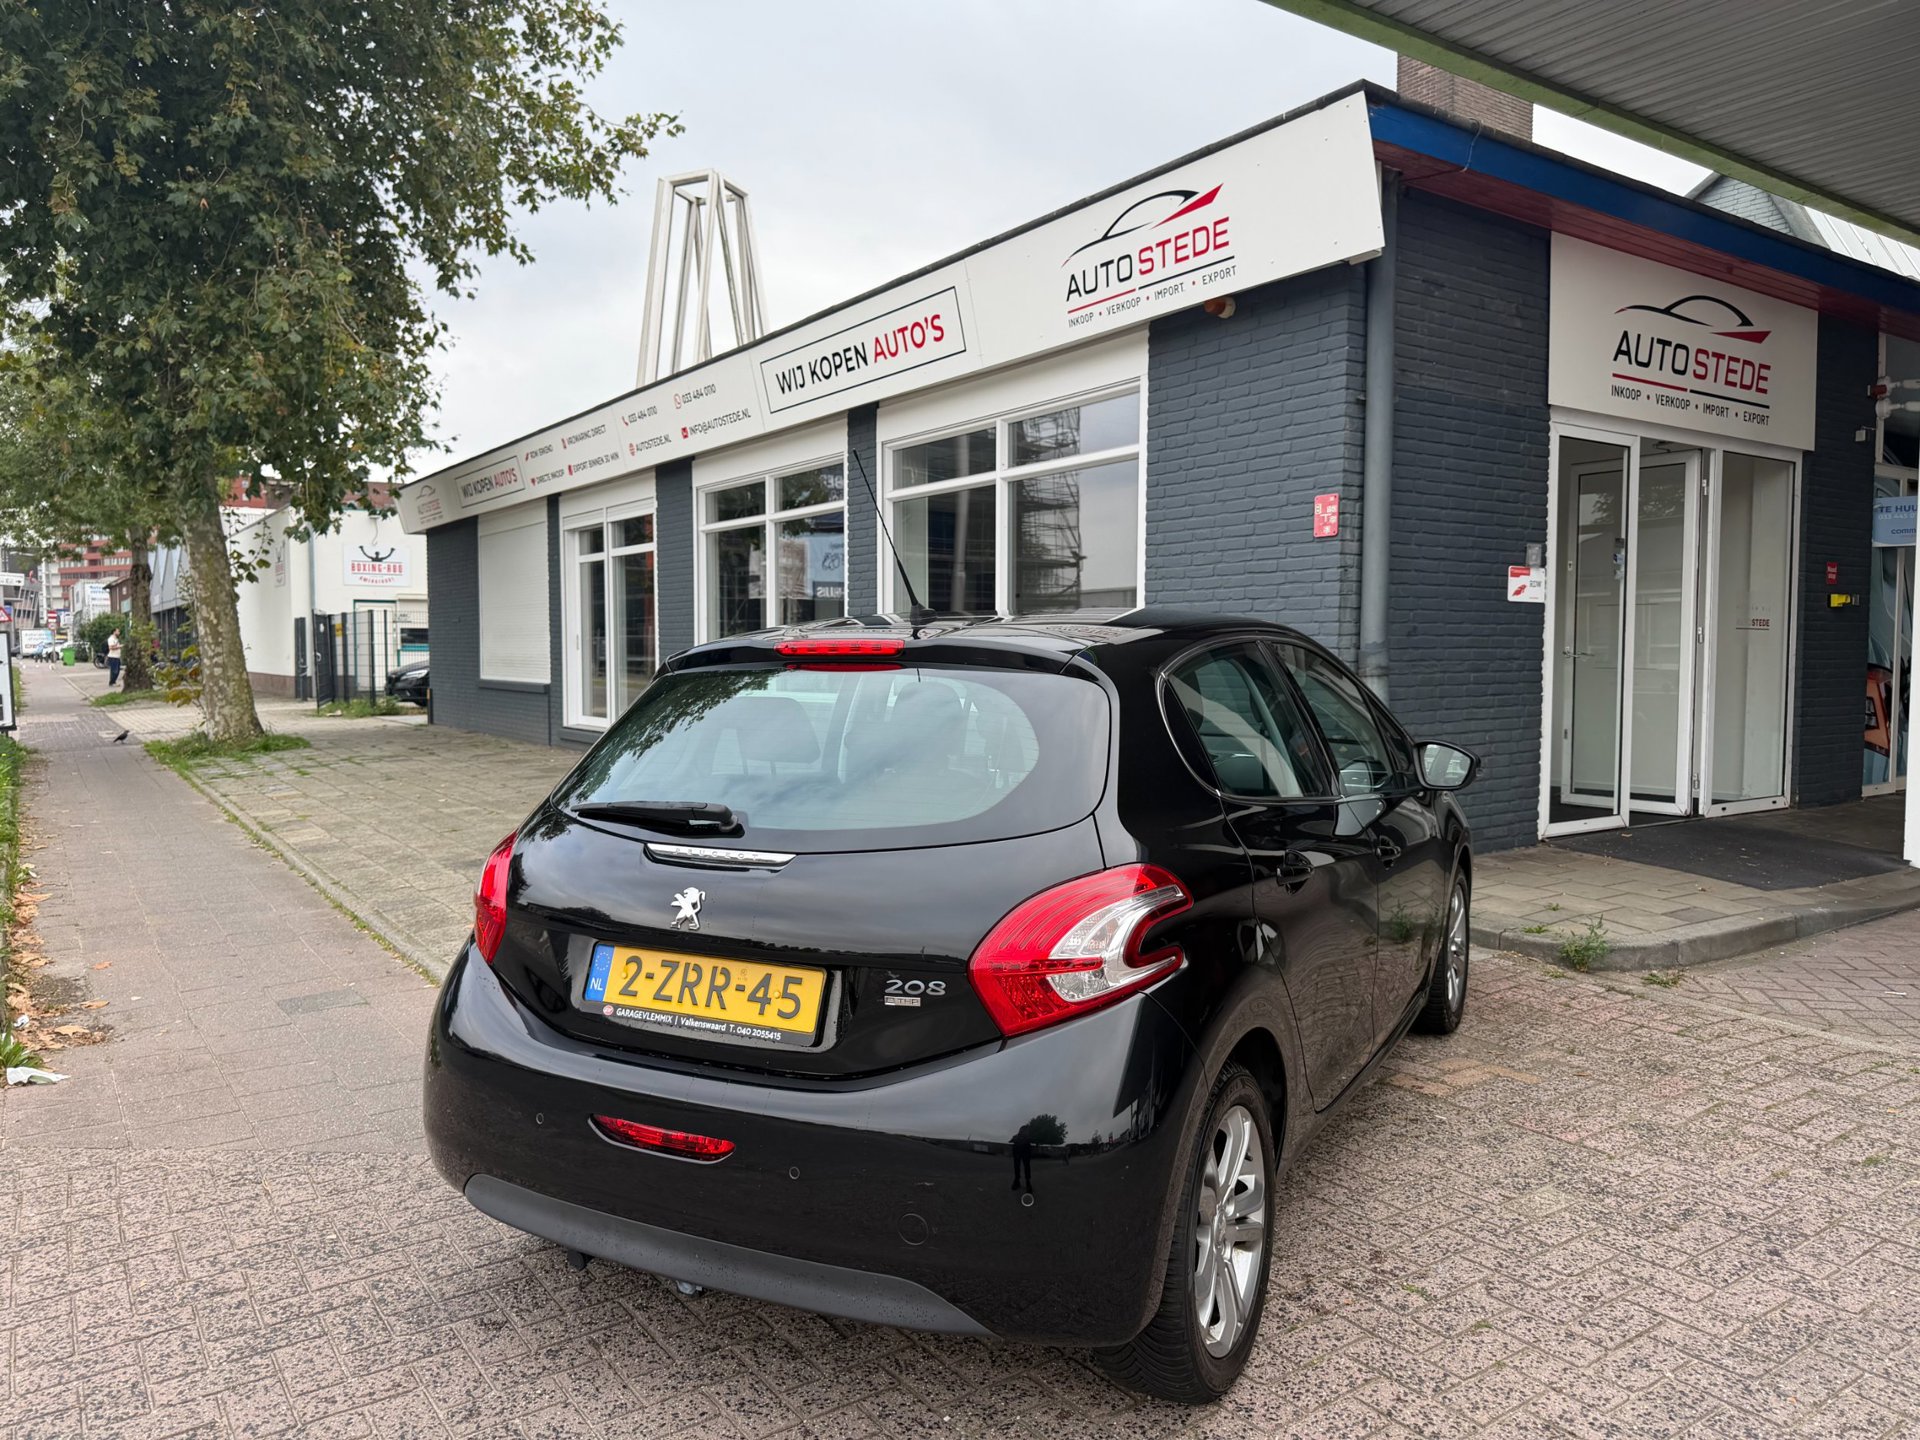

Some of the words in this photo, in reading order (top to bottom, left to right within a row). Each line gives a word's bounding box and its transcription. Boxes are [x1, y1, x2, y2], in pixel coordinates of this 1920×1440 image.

[1068, 311, 1094, 328] INKOOP
[1106, 296, 1141, 316] VERKOOP
[1154, 282, 1184, 301] IMPORT
[1202, 265, 1237, 285] EXPORT
[775, 365, 805, 395] WIJ
[808, 342, 869, 385] KOPEN
[873, 314, 945, 363] AUTO'S
[682, 392, 693, 404] 033
[693, 388, 704, 400] 484
[1611, 384, 1642, 401] INKOOP
[1655, 393, 1691, 411] VERKOOP
[1703, 402, 1730, 418] IMPORT
[1743, 411, 1770, 426] EXPORT
[637, 409, 647, 420] 484
[689, 408, 752, 435] INFO@AUTOSTEDE.NL
[636, 434, 672, 452] AUTOSTEDE.NL
[573, 462, 588, 473] EXPORT
[588, 457, 604, 468] BINNEN
[461, 485, 474, 499] WIJ
[473, 478, 494, 495] KOPEN
[493, 468, 518, 488] AUTO'S
[672, 847, 759, 861] PEUGEOT
[590, 977, 604, 991] NL
[618, 955, 803, 1020] 2-ZRR-45
[884, 979, 947, 996] 208
[616, 1007, 672, 1023] GARAGEVLEMMIX
[680, 1016, 726, 1031] Valkenswaard
[729, 1023, 736, 1033] T.
[736, 1026, 753, 1036] 040
[752, 1028, 782, 1041] 2055415
